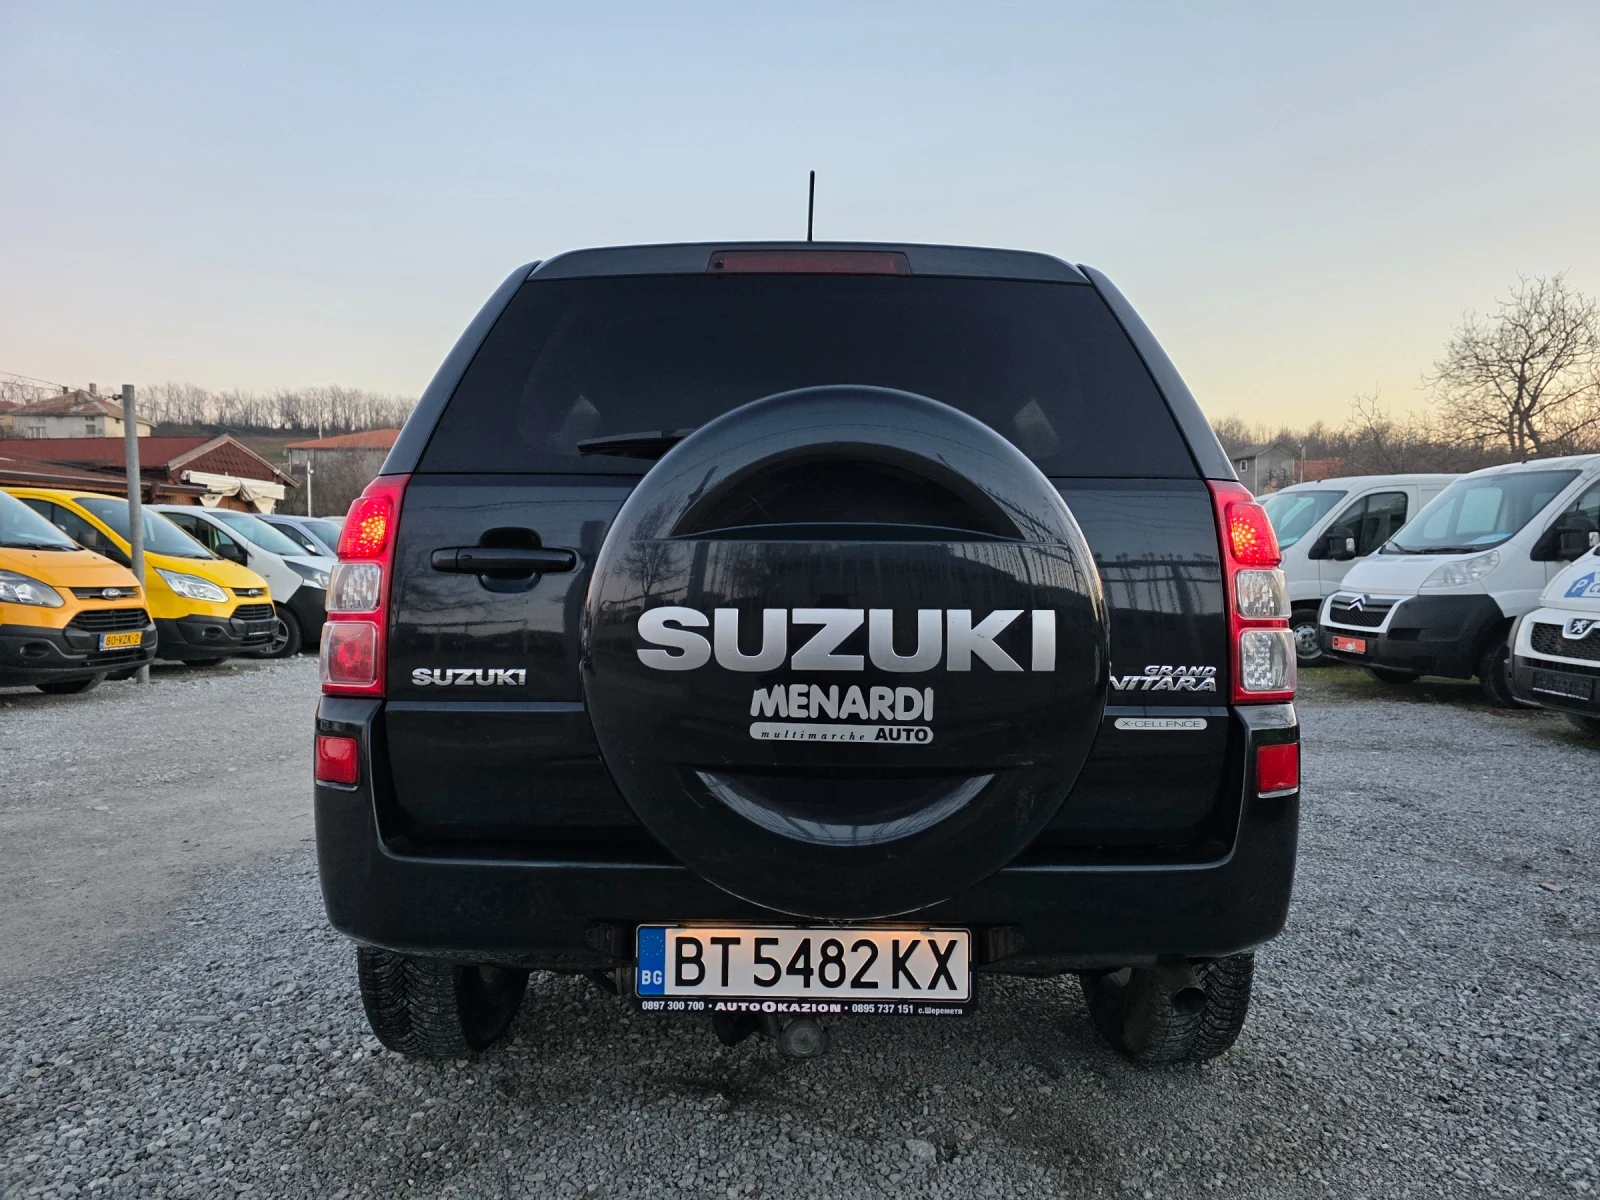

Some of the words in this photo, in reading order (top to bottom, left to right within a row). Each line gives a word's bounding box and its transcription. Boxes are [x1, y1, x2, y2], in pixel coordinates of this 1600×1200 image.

[636, 606, 1056, 673] SUZUKI
[411, 667, 527, 686] SUZUKI
[1144, 665, 1217, 676] GRAND
[1109, 675, 1217, 692] VITARA
[750, 684, 934, 722] MENARDI
[1122, 720, 1201, 728] X-CELLENCE
[760, 729, 866, 741] multimarche
[874, 727, 928, 742] AUTO
[674, 936, 741, 987] BT
[753, 938, 879, 989] 5482
[892, 939, 958, 990] KX
[641, 970, 663, 985] BG
[642, 1001, 664, 1011] 0897
[667, 1001, 685, 1011] 300
[687, 1001, 704, 1011] 700
[852, 1004, 875, 1013] 0895
[877, 1004, 894, 1014] 737
[897, 1004, 914, 1014] 151
